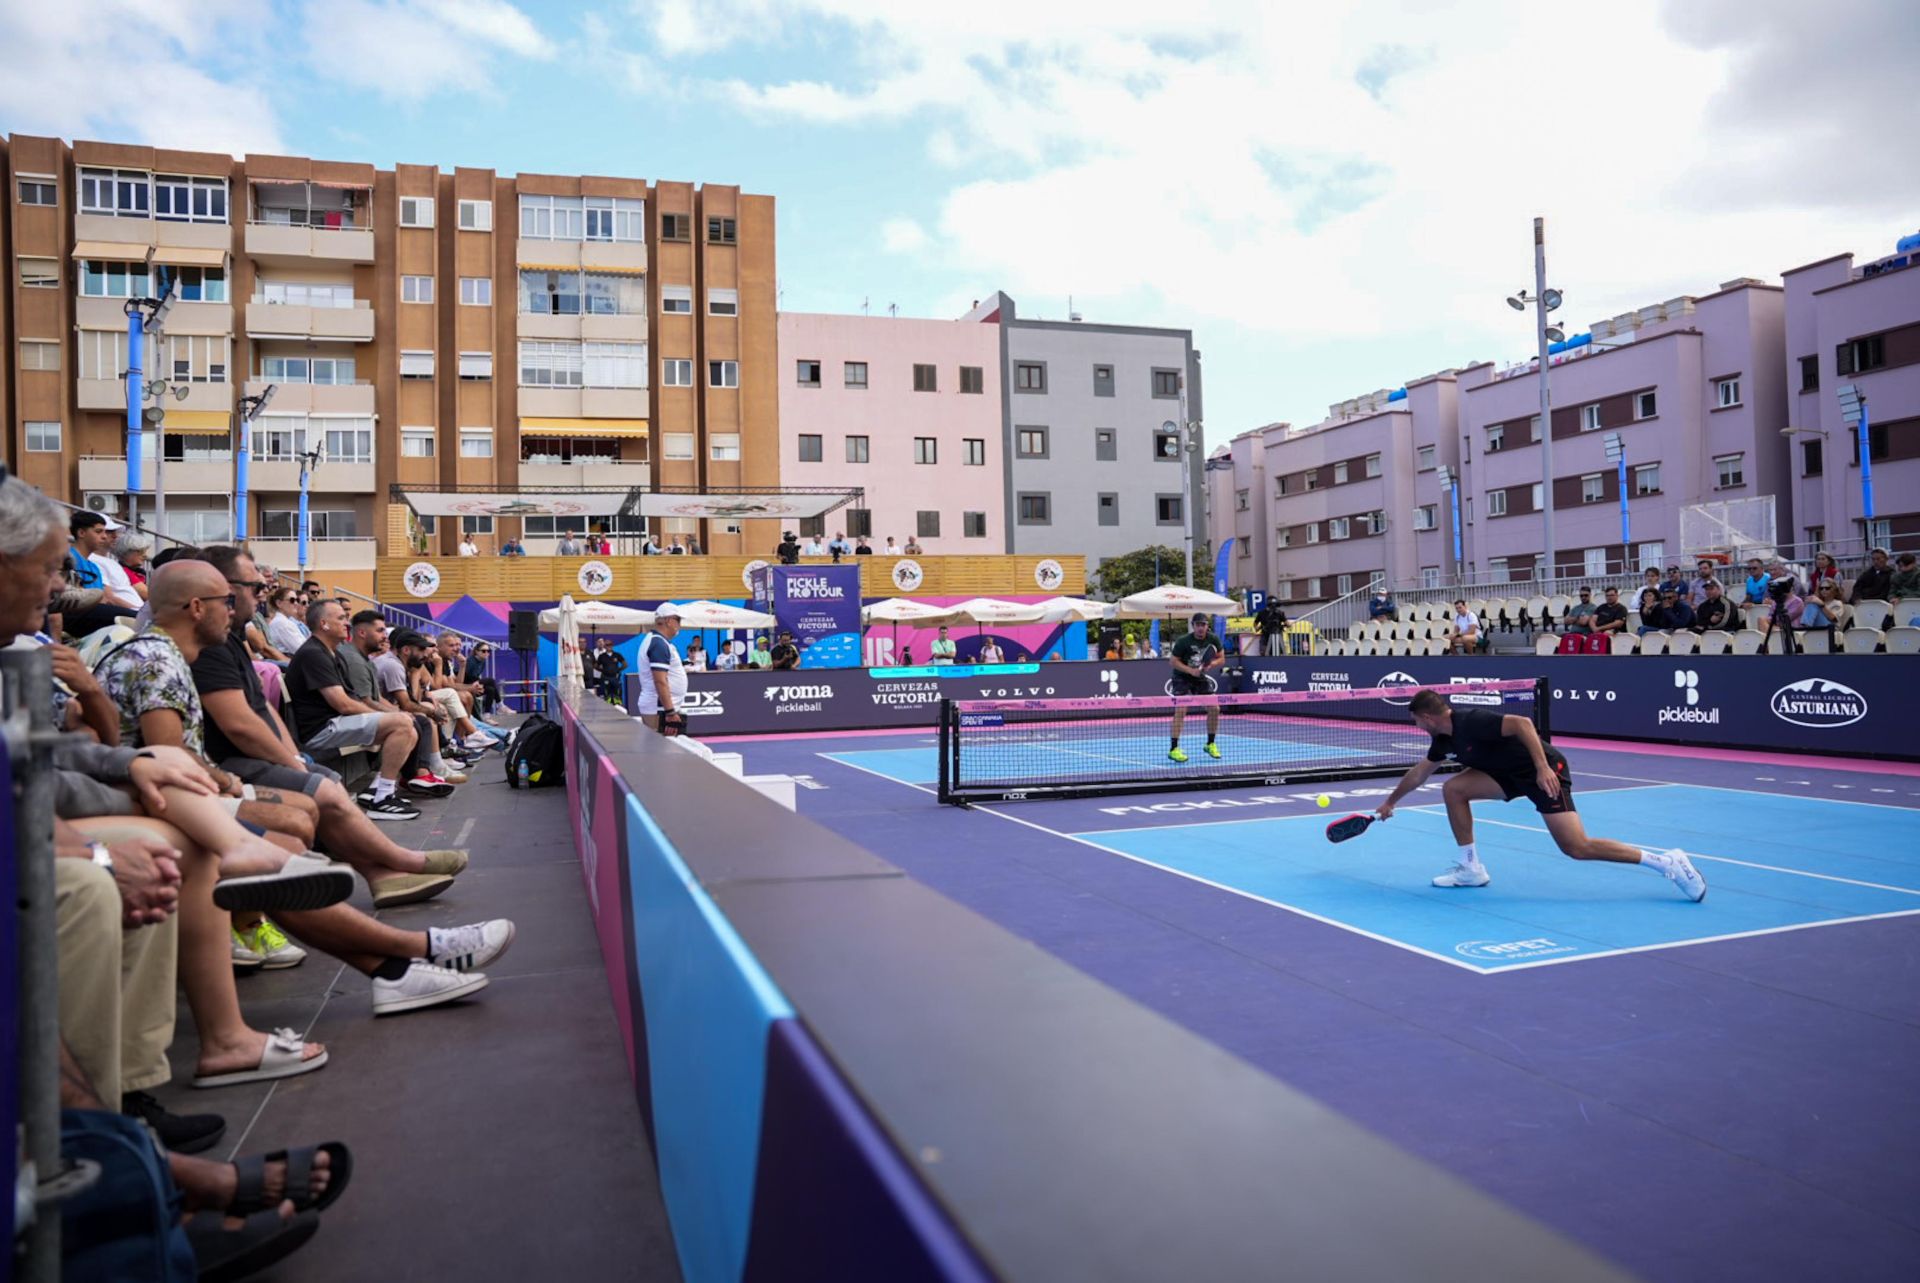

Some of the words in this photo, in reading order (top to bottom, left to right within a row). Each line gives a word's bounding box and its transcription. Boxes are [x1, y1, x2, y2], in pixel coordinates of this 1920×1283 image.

[787, 577, 828, 588] PICKLE
[1252, 593, 1263, 610] P
[797, 622, 838, 630] VICTORIA
[1311, 672, 1350, 682] CERVEZAS
[877, 682, 938, 693] CERVEZAS
[979, 686, 1056, 698] VOLVO
[682, 690, 722, 706] OX
[872, 692, 943, 705] VICTORIA
[1553, 689, 1617, 702] OLVO
[776, 702, 822, 715] pickleball
[1658, 706, 1720, 725] picklebull
[1098, 795, 1297, 816] PICKLE
